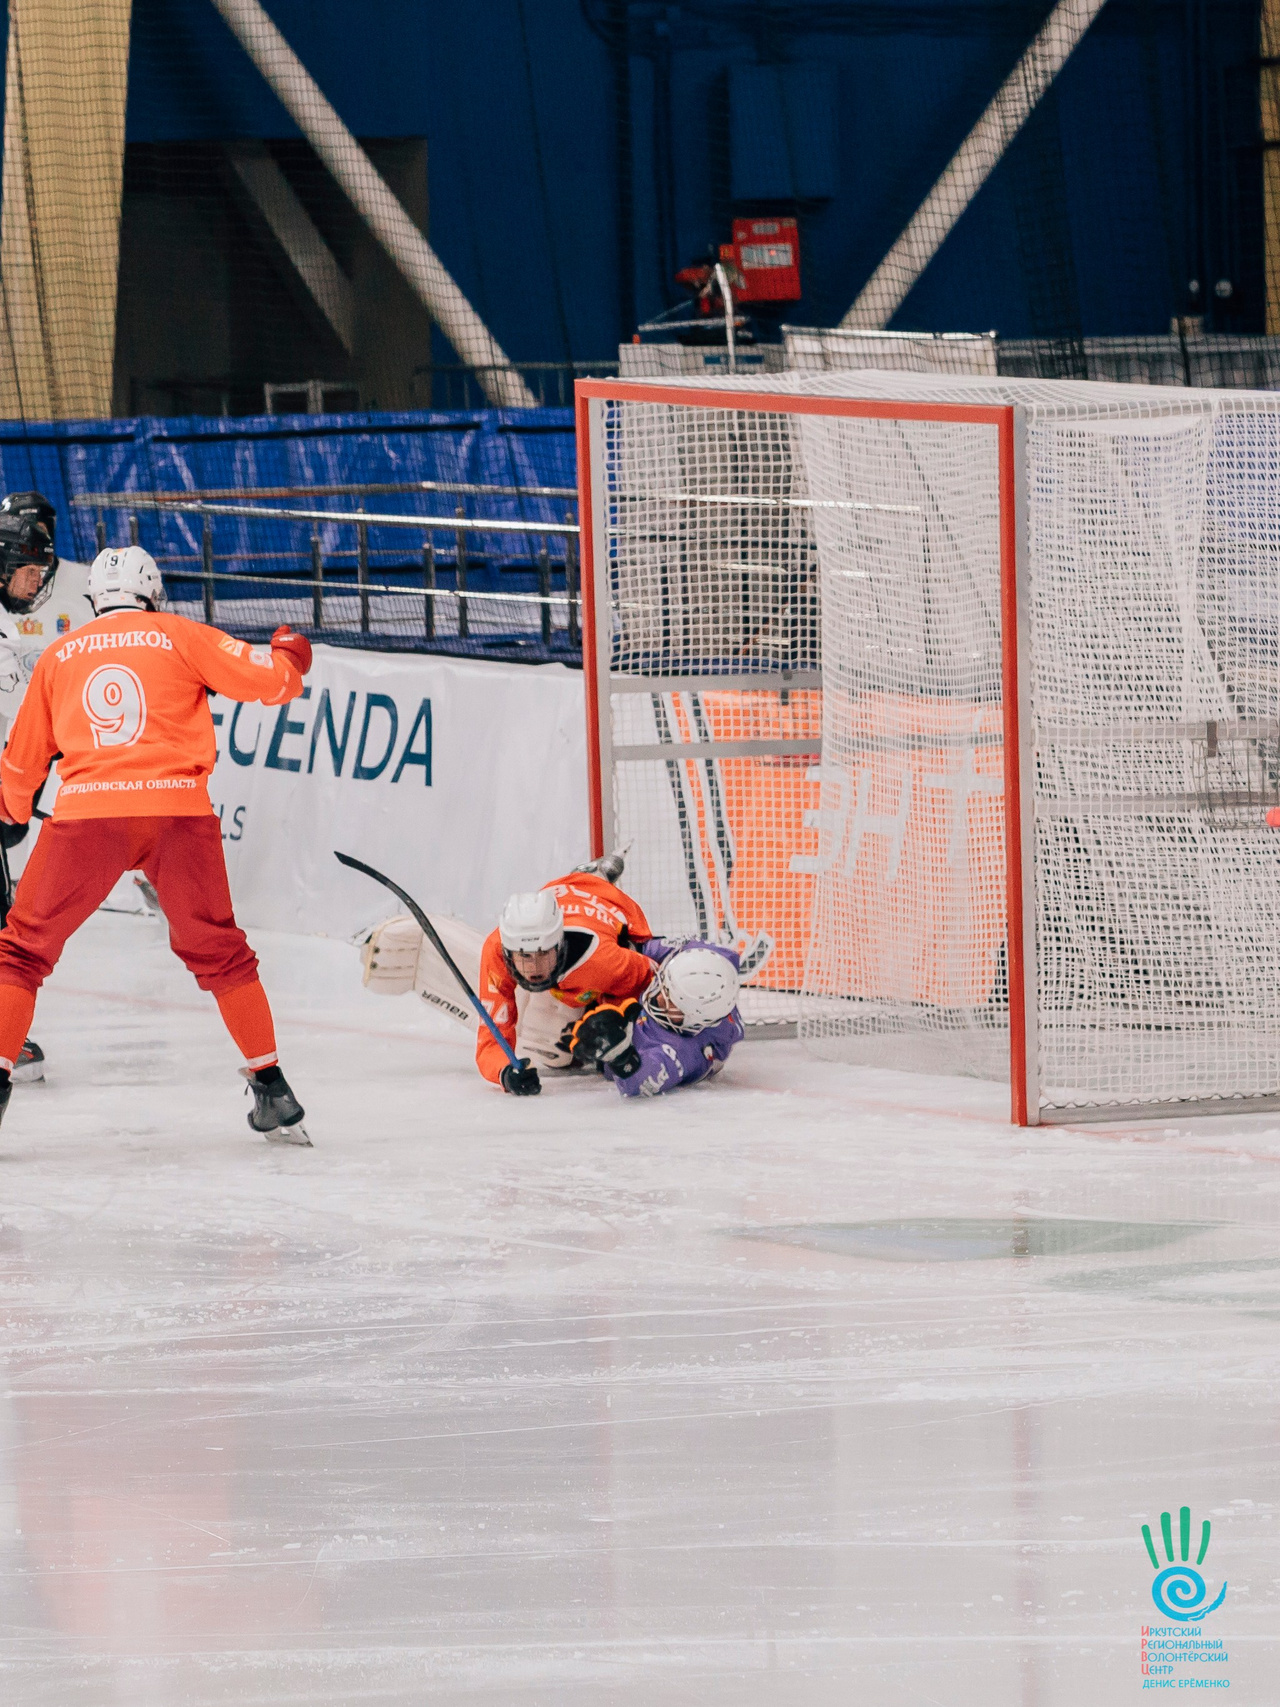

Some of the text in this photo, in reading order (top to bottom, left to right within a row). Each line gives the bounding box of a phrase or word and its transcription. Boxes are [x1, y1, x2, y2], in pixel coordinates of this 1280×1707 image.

[109, 554, 119, 567] 9
[82, 663, 147, 749] 9
[146, 778, 197, 790] ОБЛАСТЬ
